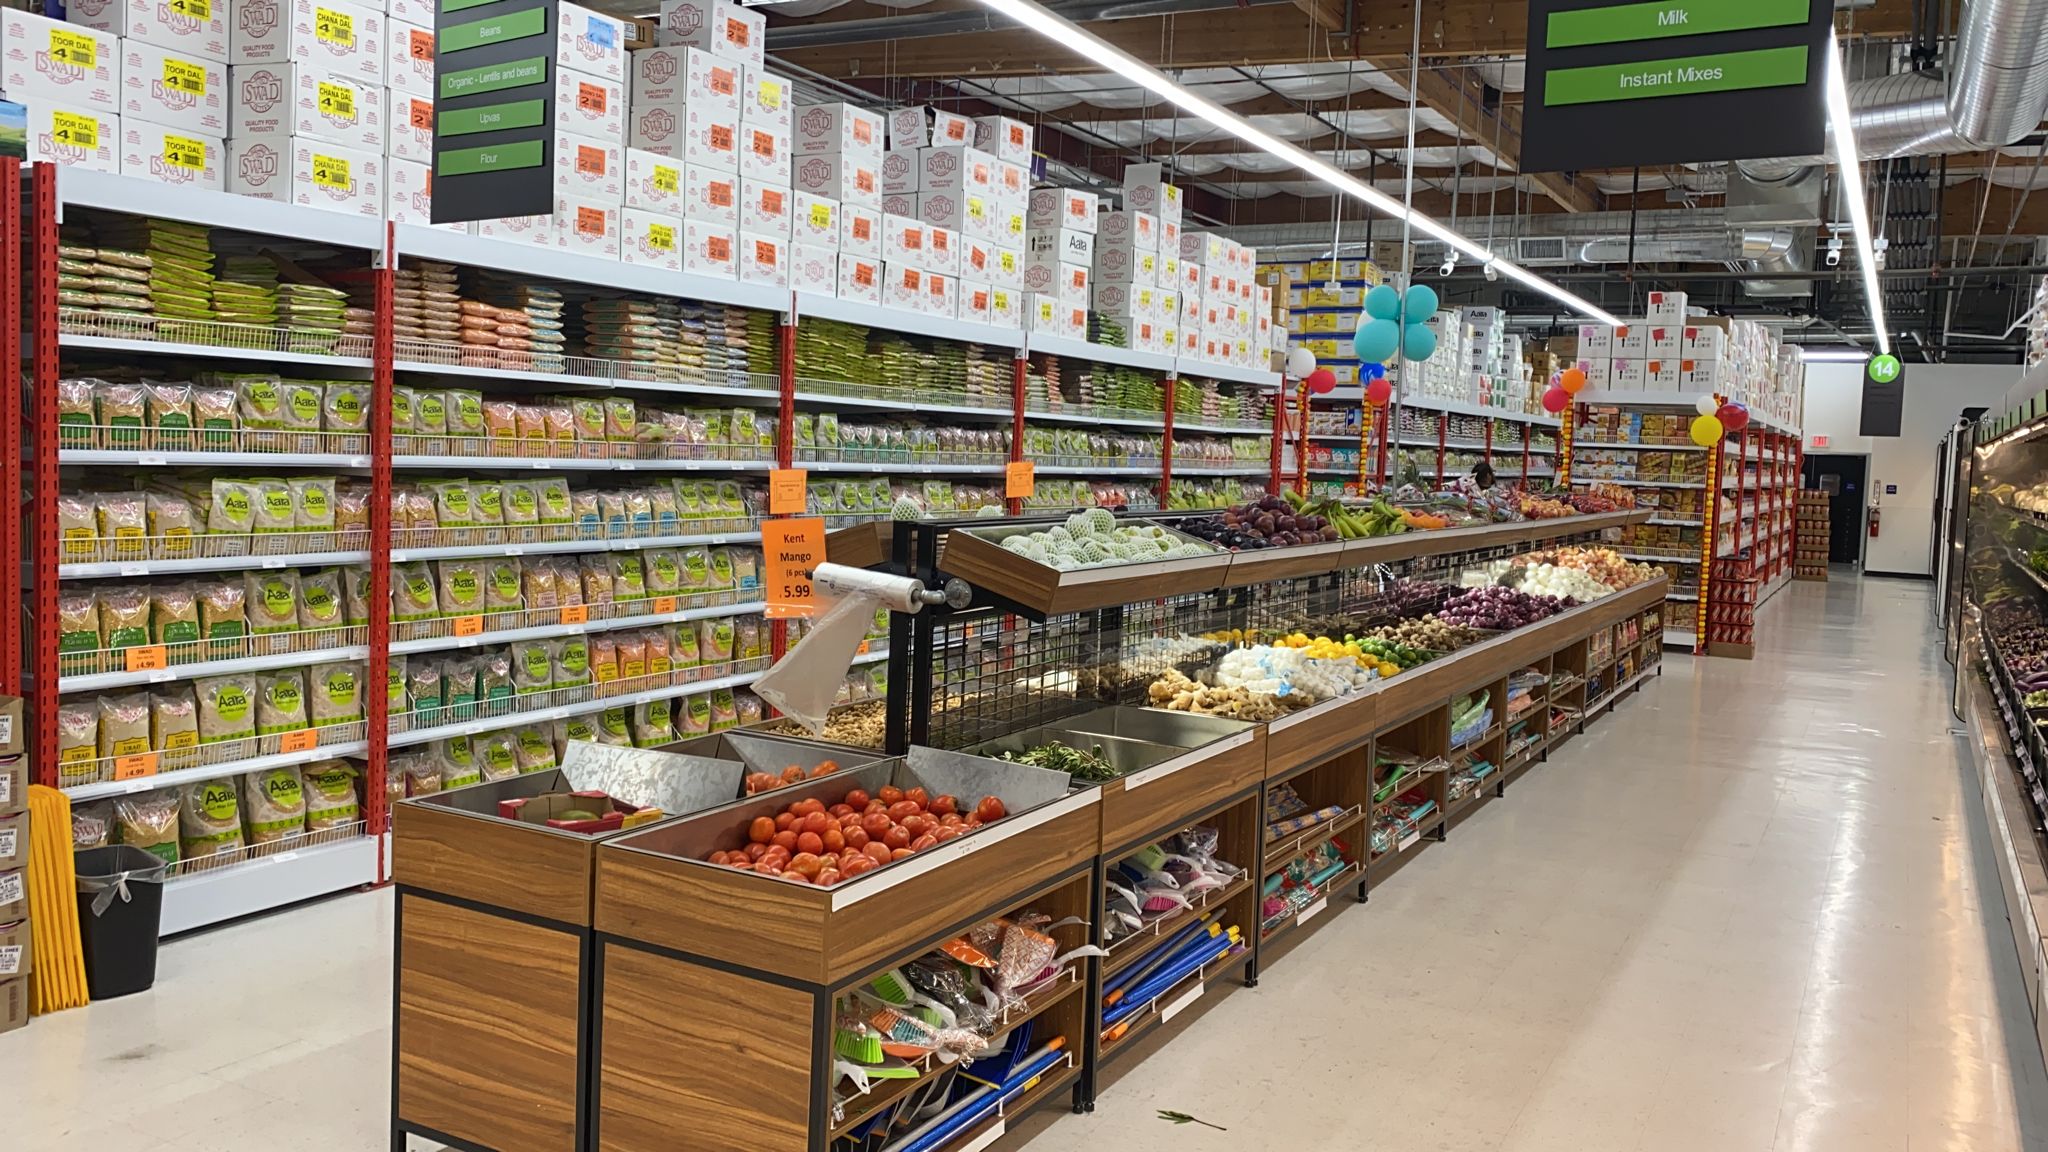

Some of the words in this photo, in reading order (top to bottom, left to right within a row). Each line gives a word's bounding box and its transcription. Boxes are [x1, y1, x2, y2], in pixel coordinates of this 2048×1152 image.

[243, 7, 276, 27] SWAD
[317, 14, 339, 26] CHANA
[339, 19, 352, 29] DAL
[671, 13, 700, 27] SWAD
[1658, 10, 1688, 26] Milk
[319, 24, 330, 33] 4
[480, 26, 502, 38] Beans
[52, 36, 74, 48] TOOR
[76, 41, 91, 51] DAL
[414, 46, 424, 55] 2
[54, 48, 68, 59] 4
[165, 64, 185, 76] TOOR
[187, 70, 201, 80] DAL
[645, 60, 675, 76] SWAD
[166, 76, 180, 86] 4
[448, 76, 473, 90] Organic
[479, 69, 501, 83] Lentils
[502, 69, 515, 80] and
[516, 64, 538, 77] beans
[1620, 70, 1673, 89] Instant
[1677, 66, 1723, 83] Mixes
[245, 82, 280, 103] SWAD
[320, 86, 339, 99] CHANA
[340, 93, 353, 102] DAL
[321, 98, 332, 107] 4
[54, 117, 77, 129] TOOR
[78, 122, 94, 132] DAL
[414, 116, 424, 125] 2
[480, 113, 501, 125] Upvas
[643, 118, 673, 133] SWAD
[56, 130, 70, 140] 4
[166, 141, 185, 152] TOOR
[187, 145, 201, 155] DAL
[167, 152, 180, 162] 4
[480, 152, 499, 165] Flour
[242, 154, 276, 176] SWAD
[314, 159, 335, 171] CHANA
[336, 164, 349, 173] DAL
[316, 169, 327, 179] 4
[1874, 361, 1895, 377] 14
[783, 533, 806, 544] Kent
[780, 552, 812, 564] Mango
[786, 568, 794, 578] (6
[783, 584, 811, 598] 5.99
